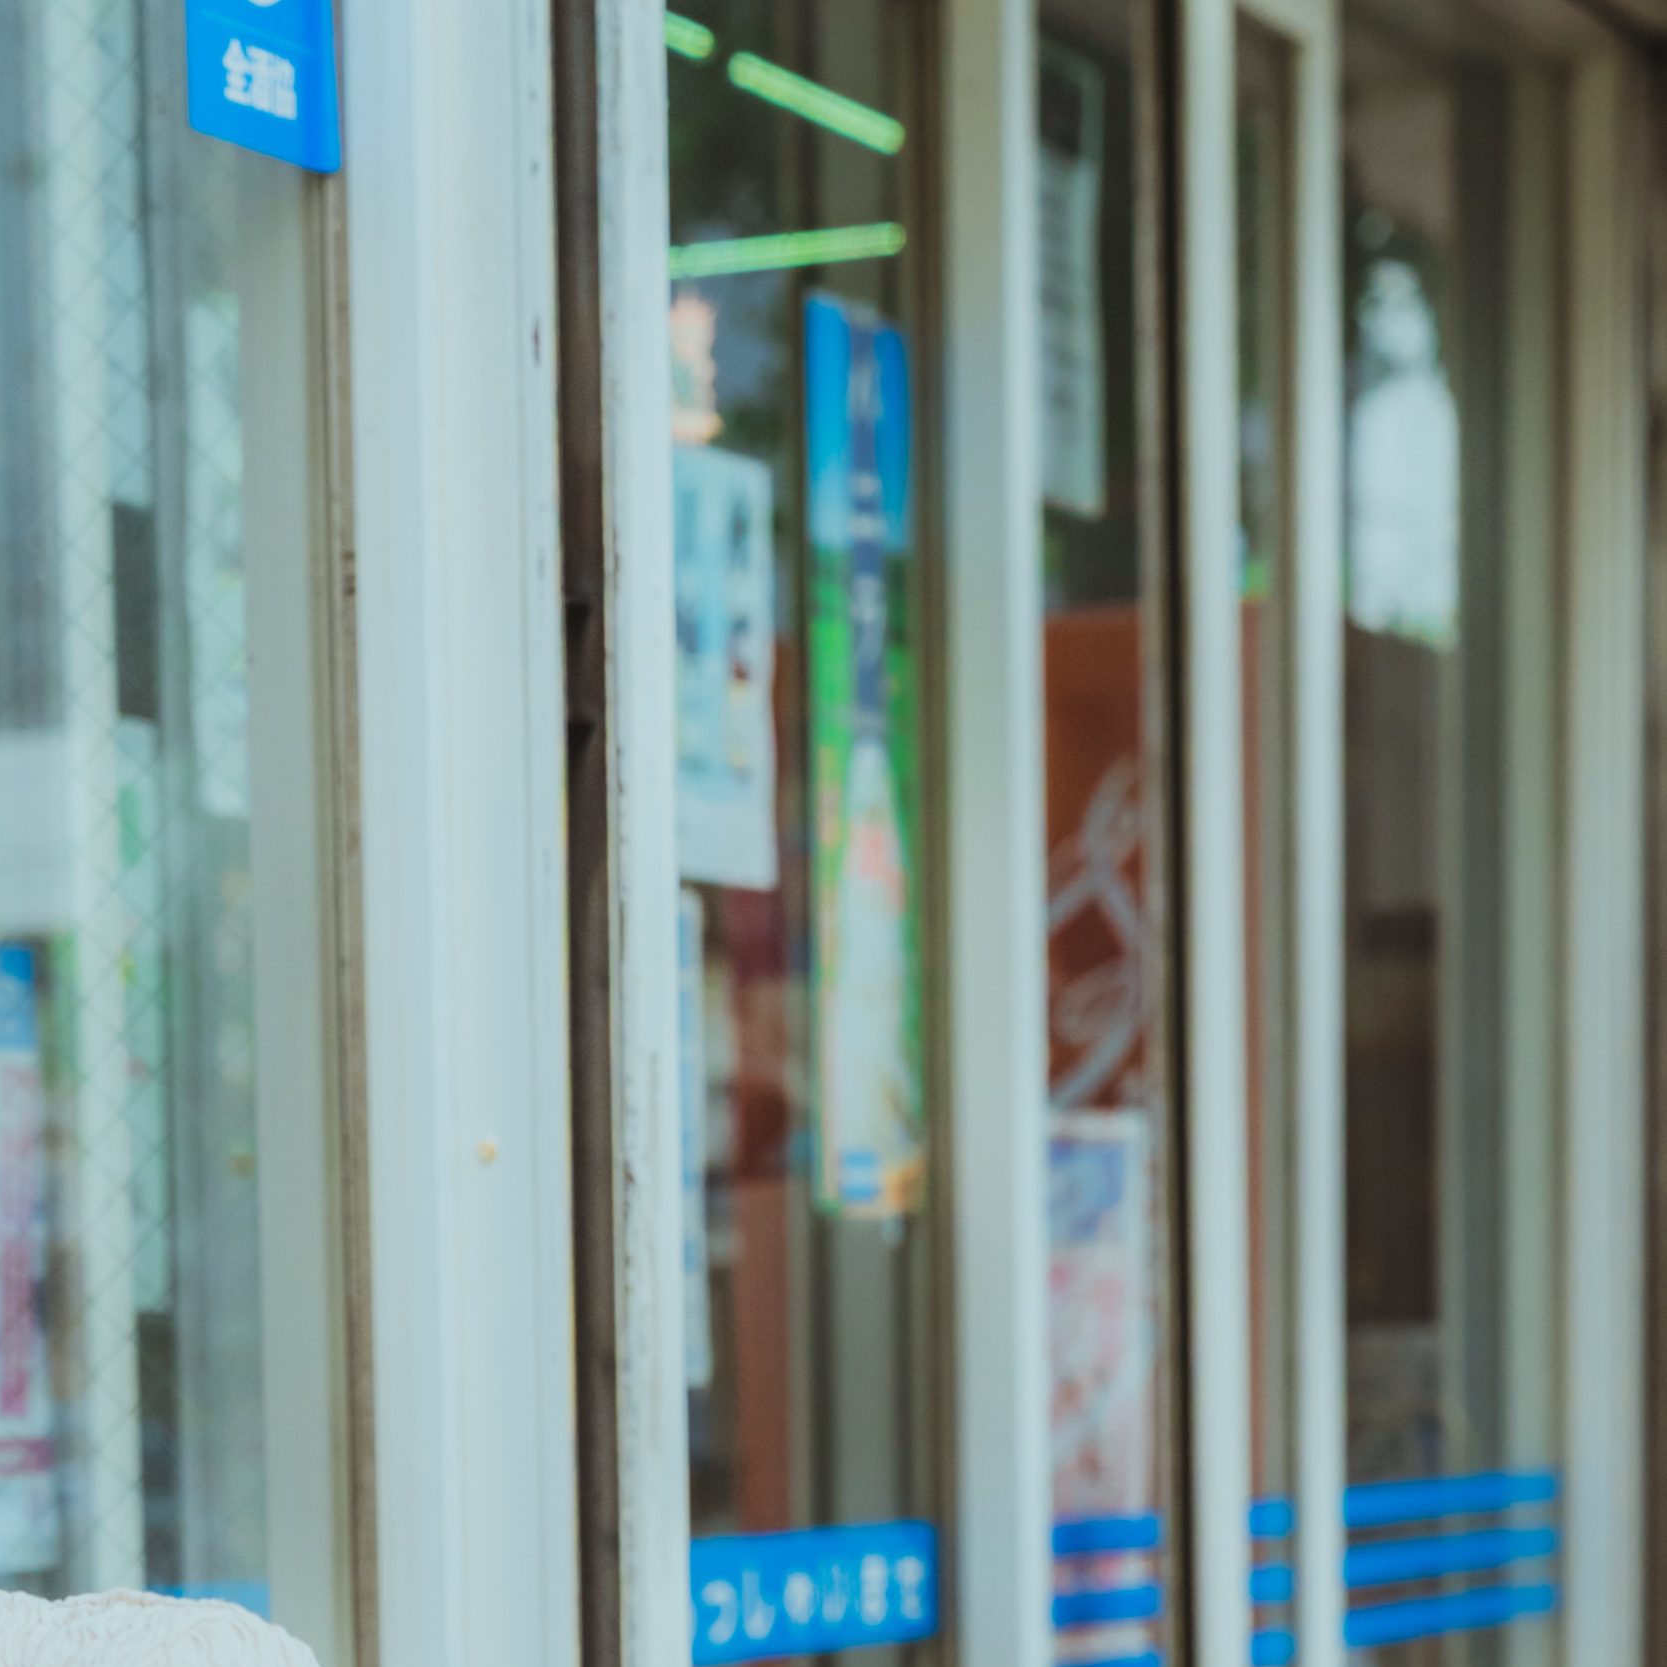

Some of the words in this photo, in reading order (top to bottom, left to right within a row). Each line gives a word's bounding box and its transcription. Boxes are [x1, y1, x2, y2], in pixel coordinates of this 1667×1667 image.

[692, 1554, 926, 1645] っしゃいませ
